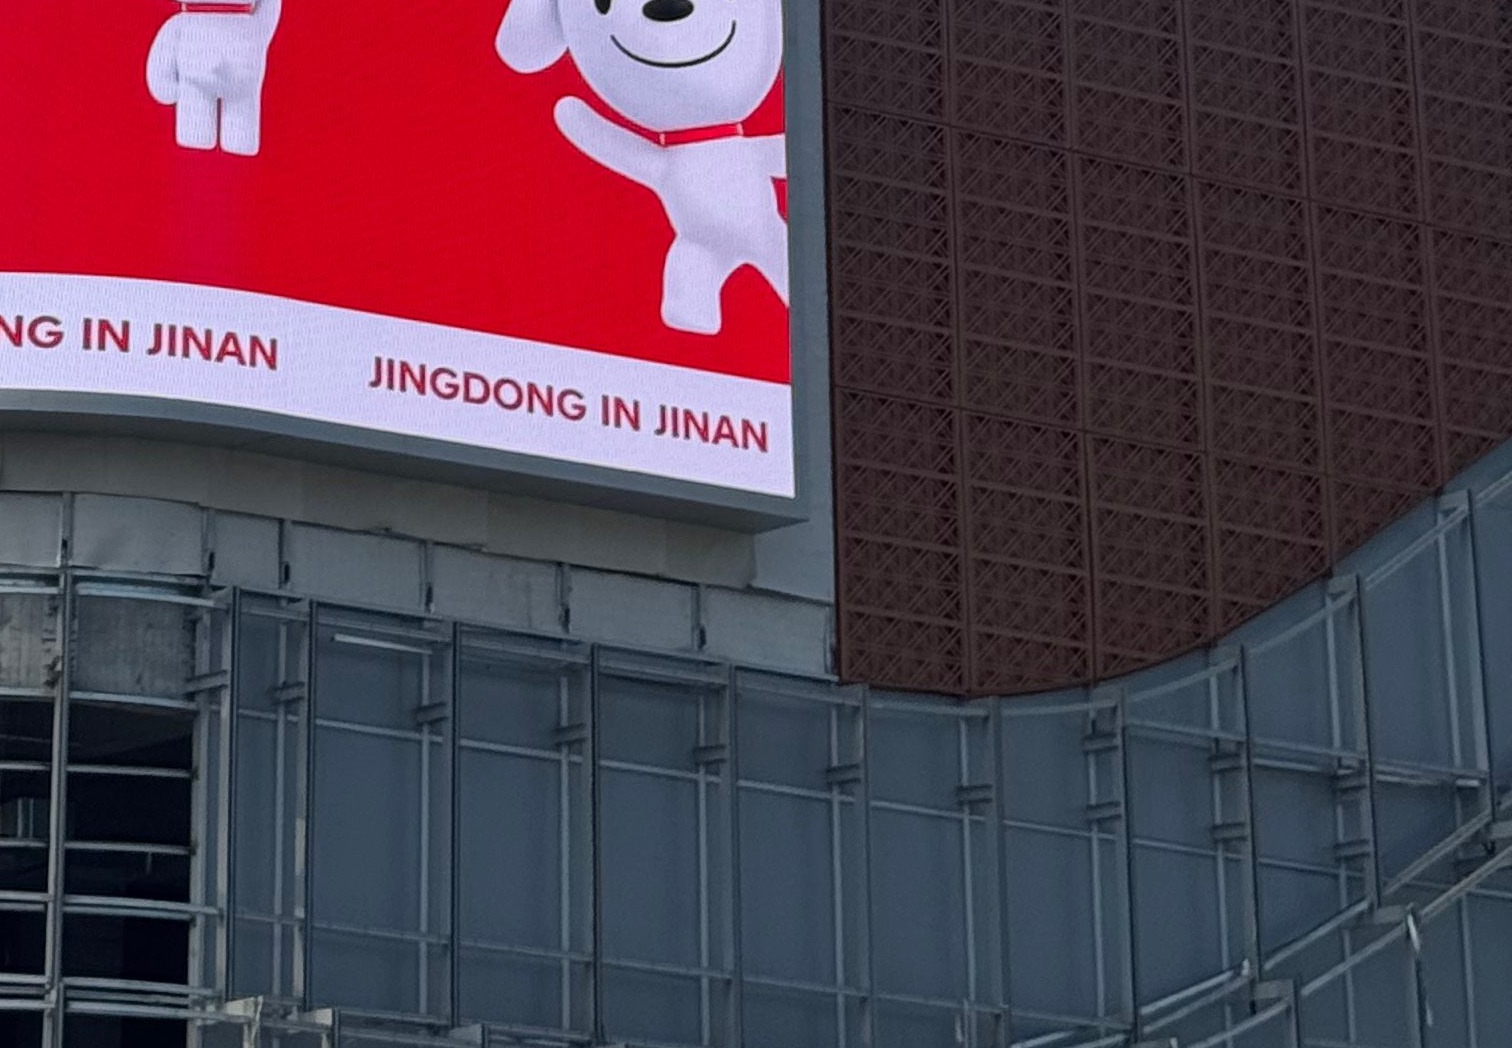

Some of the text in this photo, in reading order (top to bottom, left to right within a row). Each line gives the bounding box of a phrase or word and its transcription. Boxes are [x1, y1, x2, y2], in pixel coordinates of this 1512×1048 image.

[82, 317, 130, 352] IN
[146, 322, 278, 369] JINAN
[369, 356, 769, 452] JINGDONG IN JINAN
